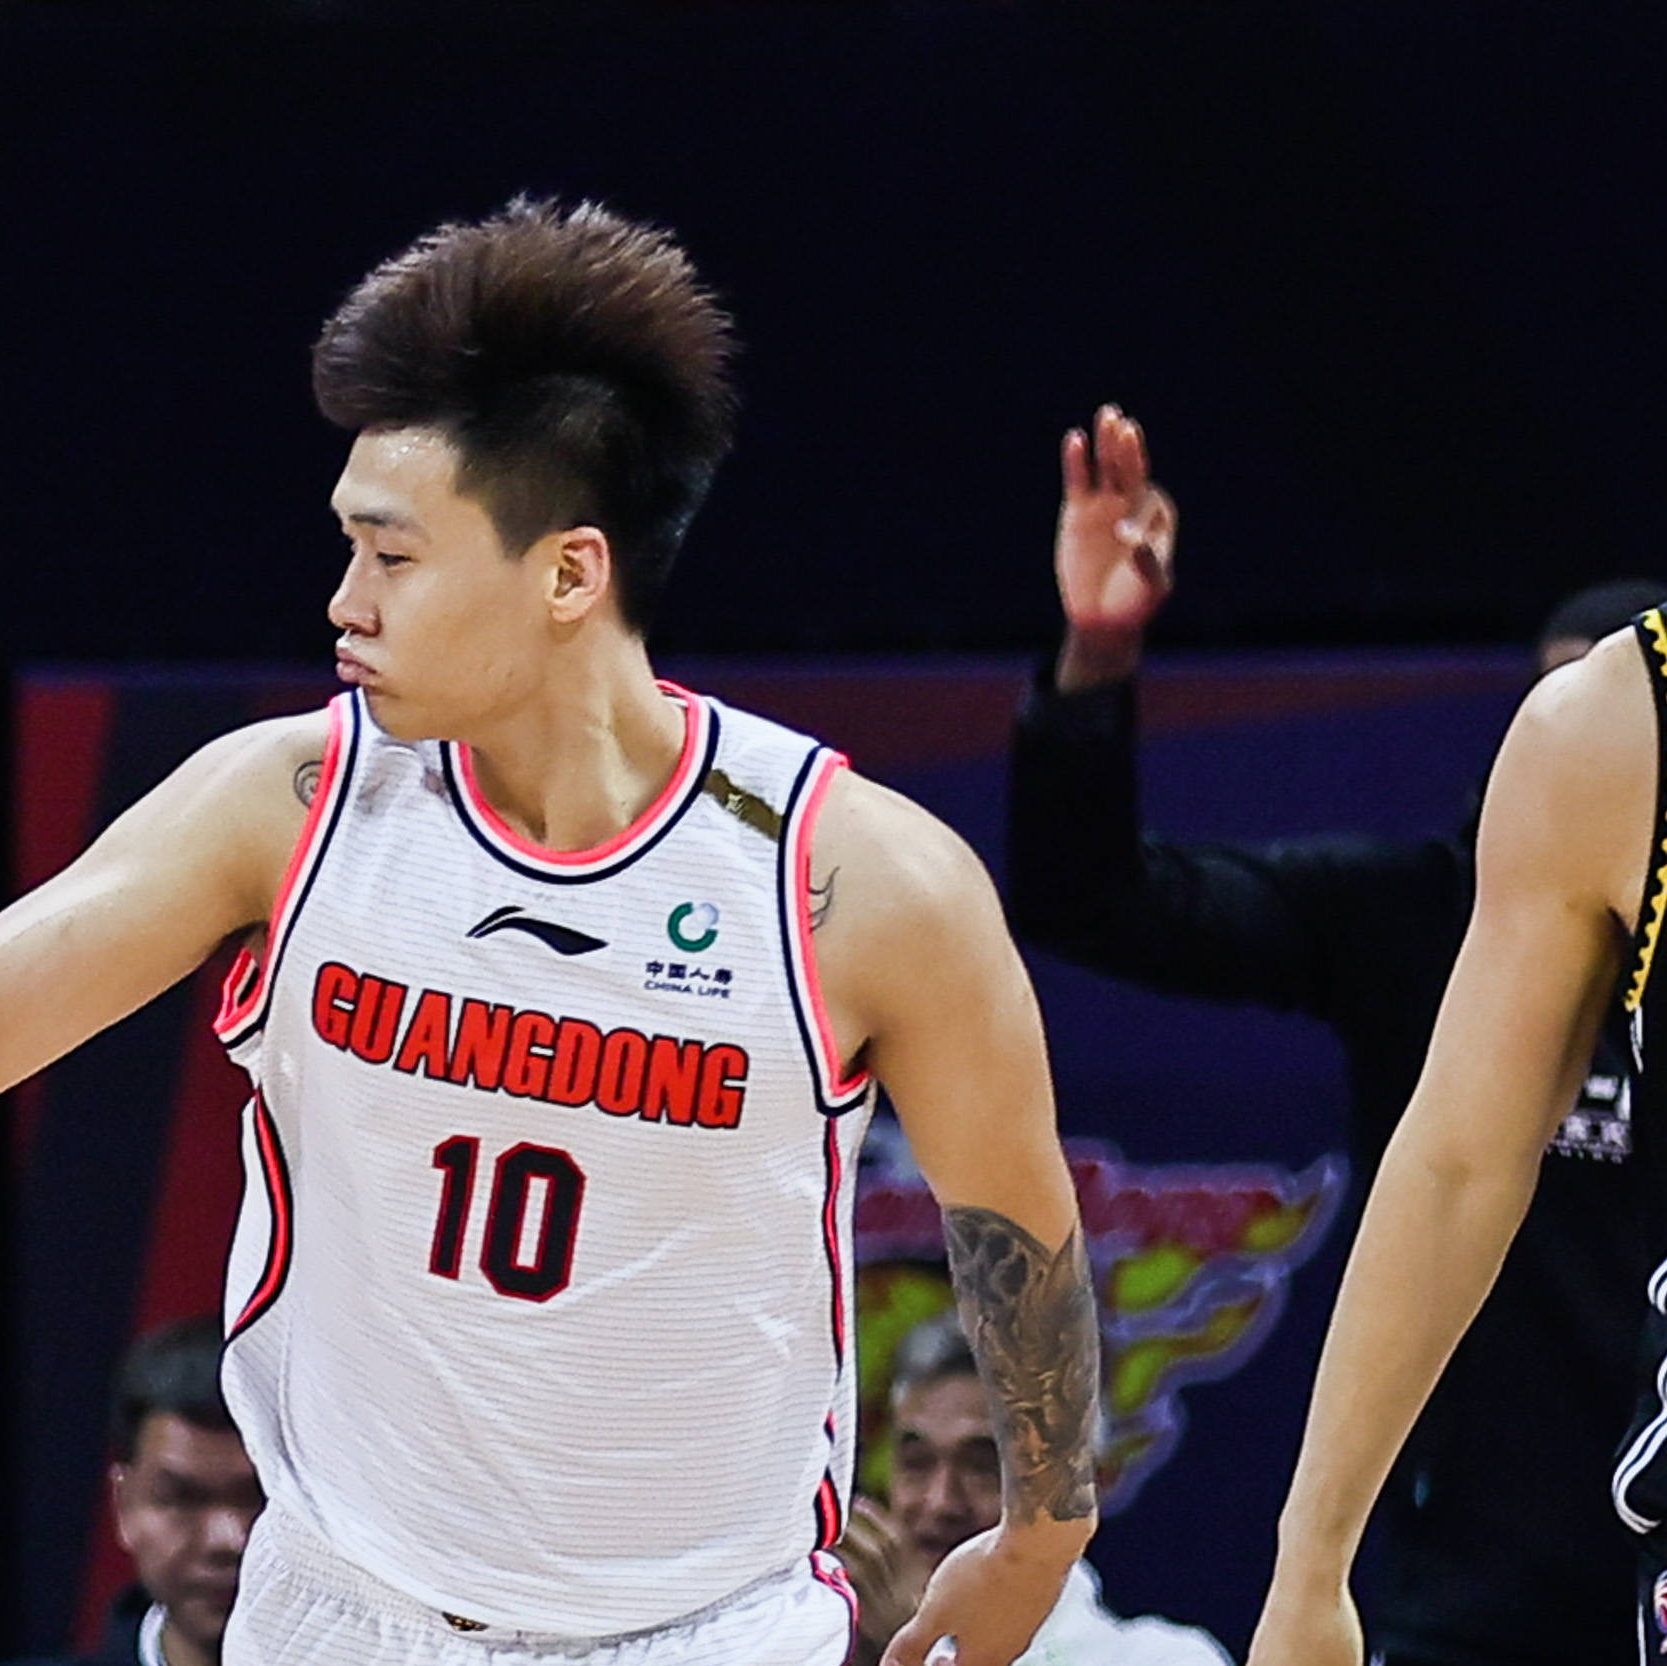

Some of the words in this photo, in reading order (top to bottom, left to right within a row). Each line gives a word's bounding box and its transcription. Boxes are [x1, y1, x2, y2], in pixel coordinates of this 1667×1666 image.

[310, 961, 750, 1130] GUANGDONG
[644, 981, 692, 993] CHINA
[428, 1135, 587, 1304] 10
